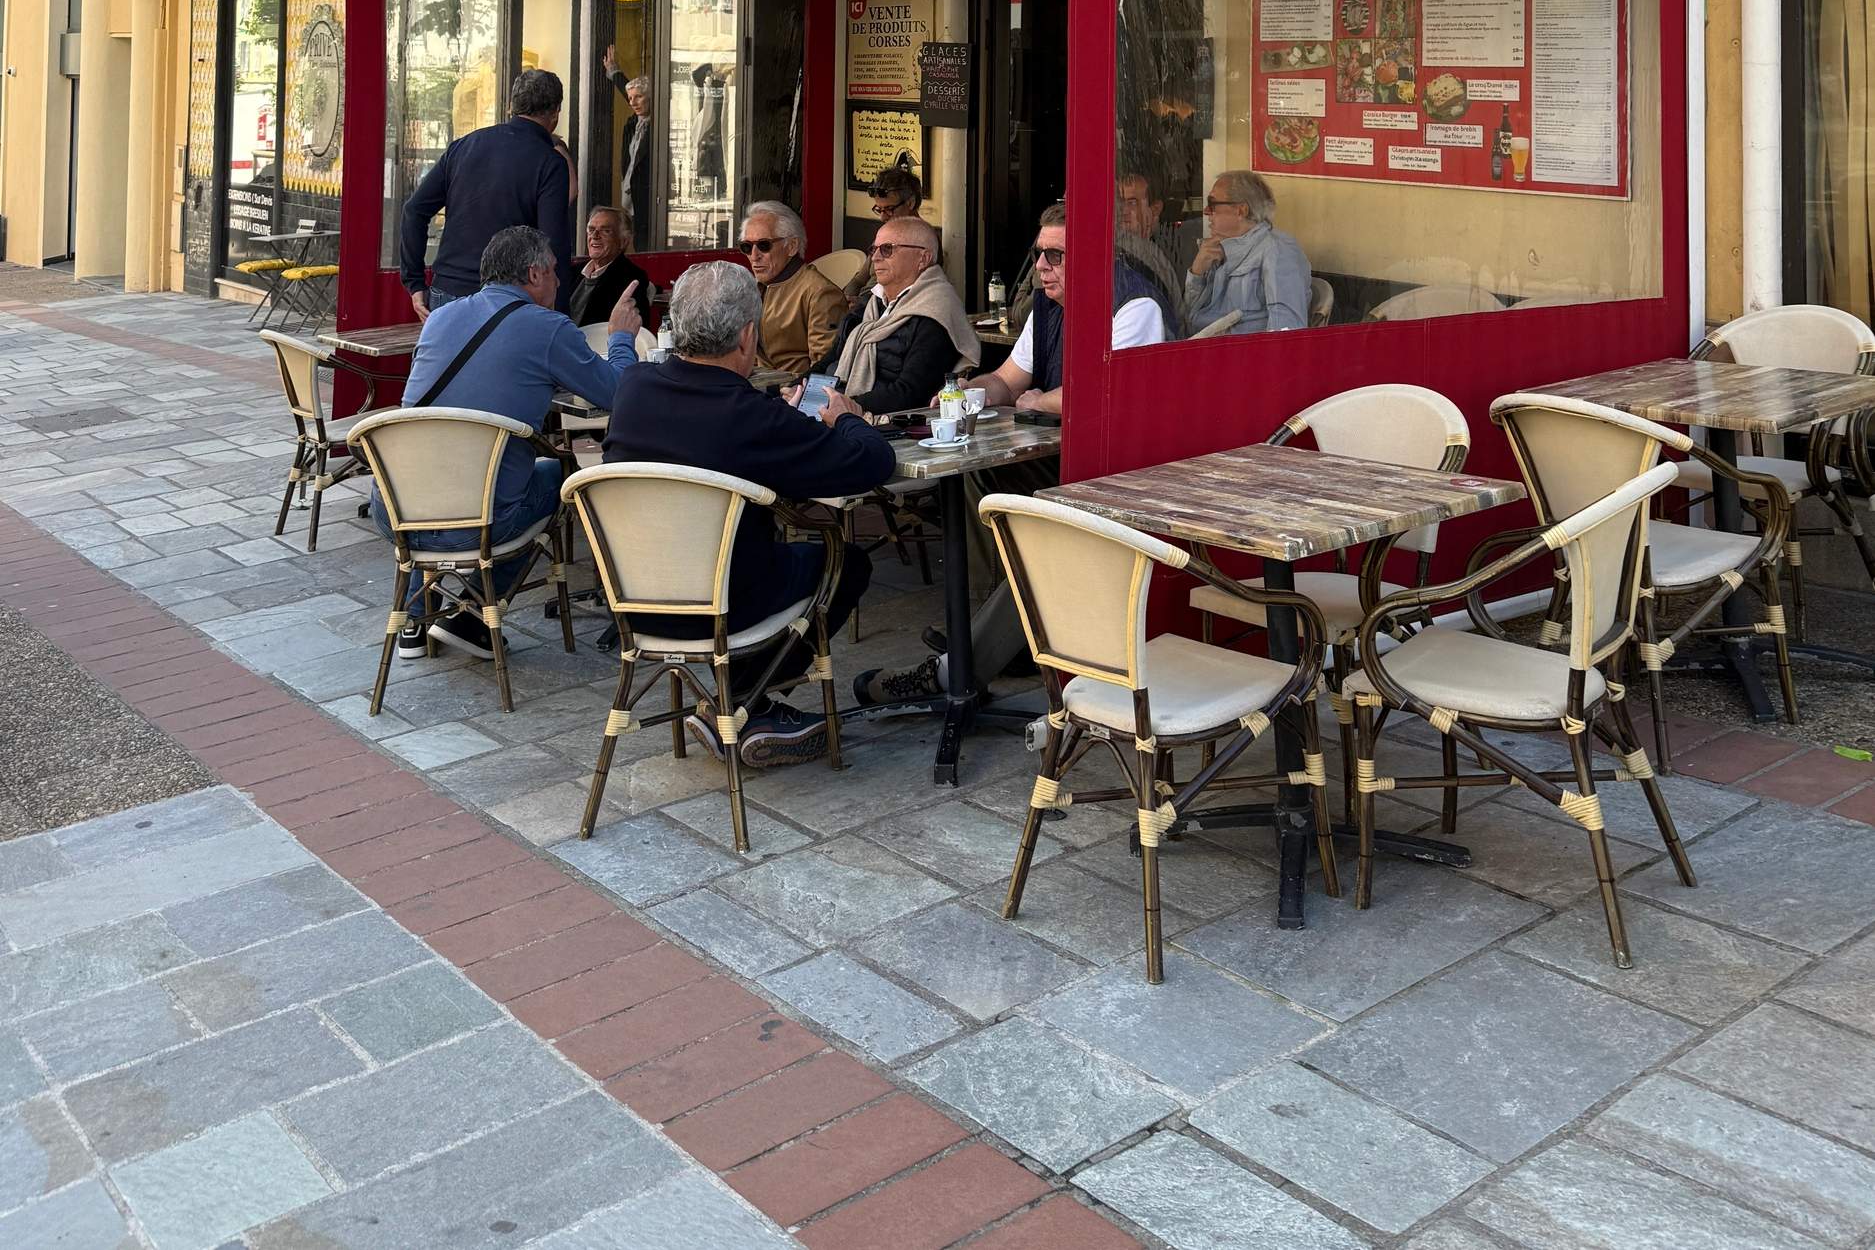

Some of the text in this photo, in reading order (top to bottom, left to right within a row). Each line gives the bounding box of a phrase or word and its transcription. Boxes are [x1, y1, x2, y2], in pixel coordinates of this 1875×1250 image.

[851, 2, 863, 13] ICI
[868, 5, 912, 21] VENTE
[852, 20, 927, 35] DE PRODUITS
[868, 34, 911, 48] CORSES
[922, 45, 967, 57] GLACES
[927, 85, 965, 96] DESSERTS
